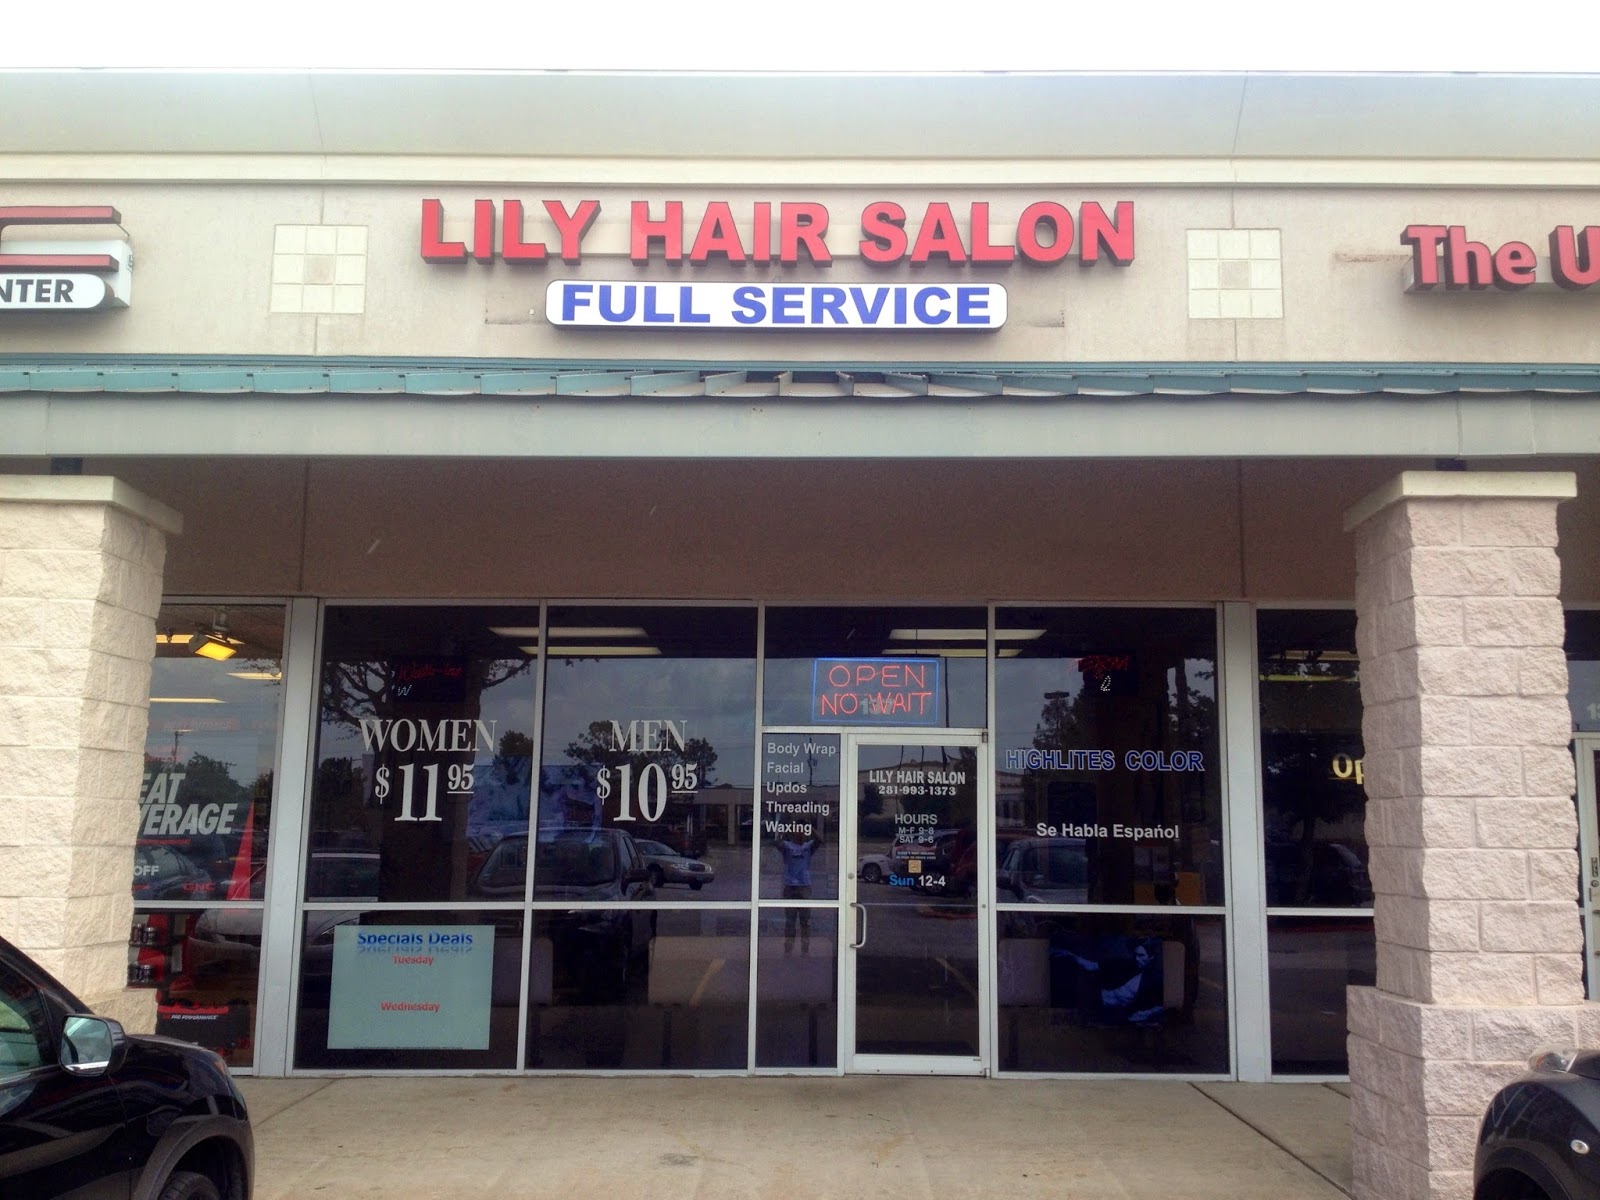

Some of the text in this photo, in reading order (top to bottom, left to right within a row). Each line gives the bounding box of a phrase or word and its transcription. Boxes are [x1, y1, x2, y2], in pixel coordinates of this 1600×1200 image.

[421, 199, 1135, 267] LILY HAIR SALON
[1400, 224, 1537, 290] The
[562, 284, 991, 325] FULL SERVICE
[828, 664, 926, 689] OPEN
[820, 691, 933, 715] NO WAIT
[358, 718, 497, 752] WOMEN
[609, 719, 688, 752] MEN
[767, 742, 837, 757] Body Wrap
[767, 762, 804, 774] Facial
[1005, 749, 1206, 772] HIGHLITES COLOR
[869, 770, 966, 785] LILY HAIR SALON
[766, 781, 808, 796] Updos
[878, 785, 957, 796] 281-993-1373
[765, 801, 831, 817] Threading
[894, 813, 938, 825] HOURS
[765, 820, 813, 836] Waxing
[898, 826, 935, 835] M-F 9-8
[1036, 822, 1058, 837] Se
[1062, 823, 1109, 838] Habla
[899, 836, 935, 844] SAT 9-6
[133, 865, 159, 876] OFF
[183, 882, 216, 892] GNC
[889, 875, 947, 888] Sun 12-4
[357, 930, 474, 947] Specials Deals
[393, 954, 434, 966] Tuesday
[381, 1002, 440, 1013] Wednesday
